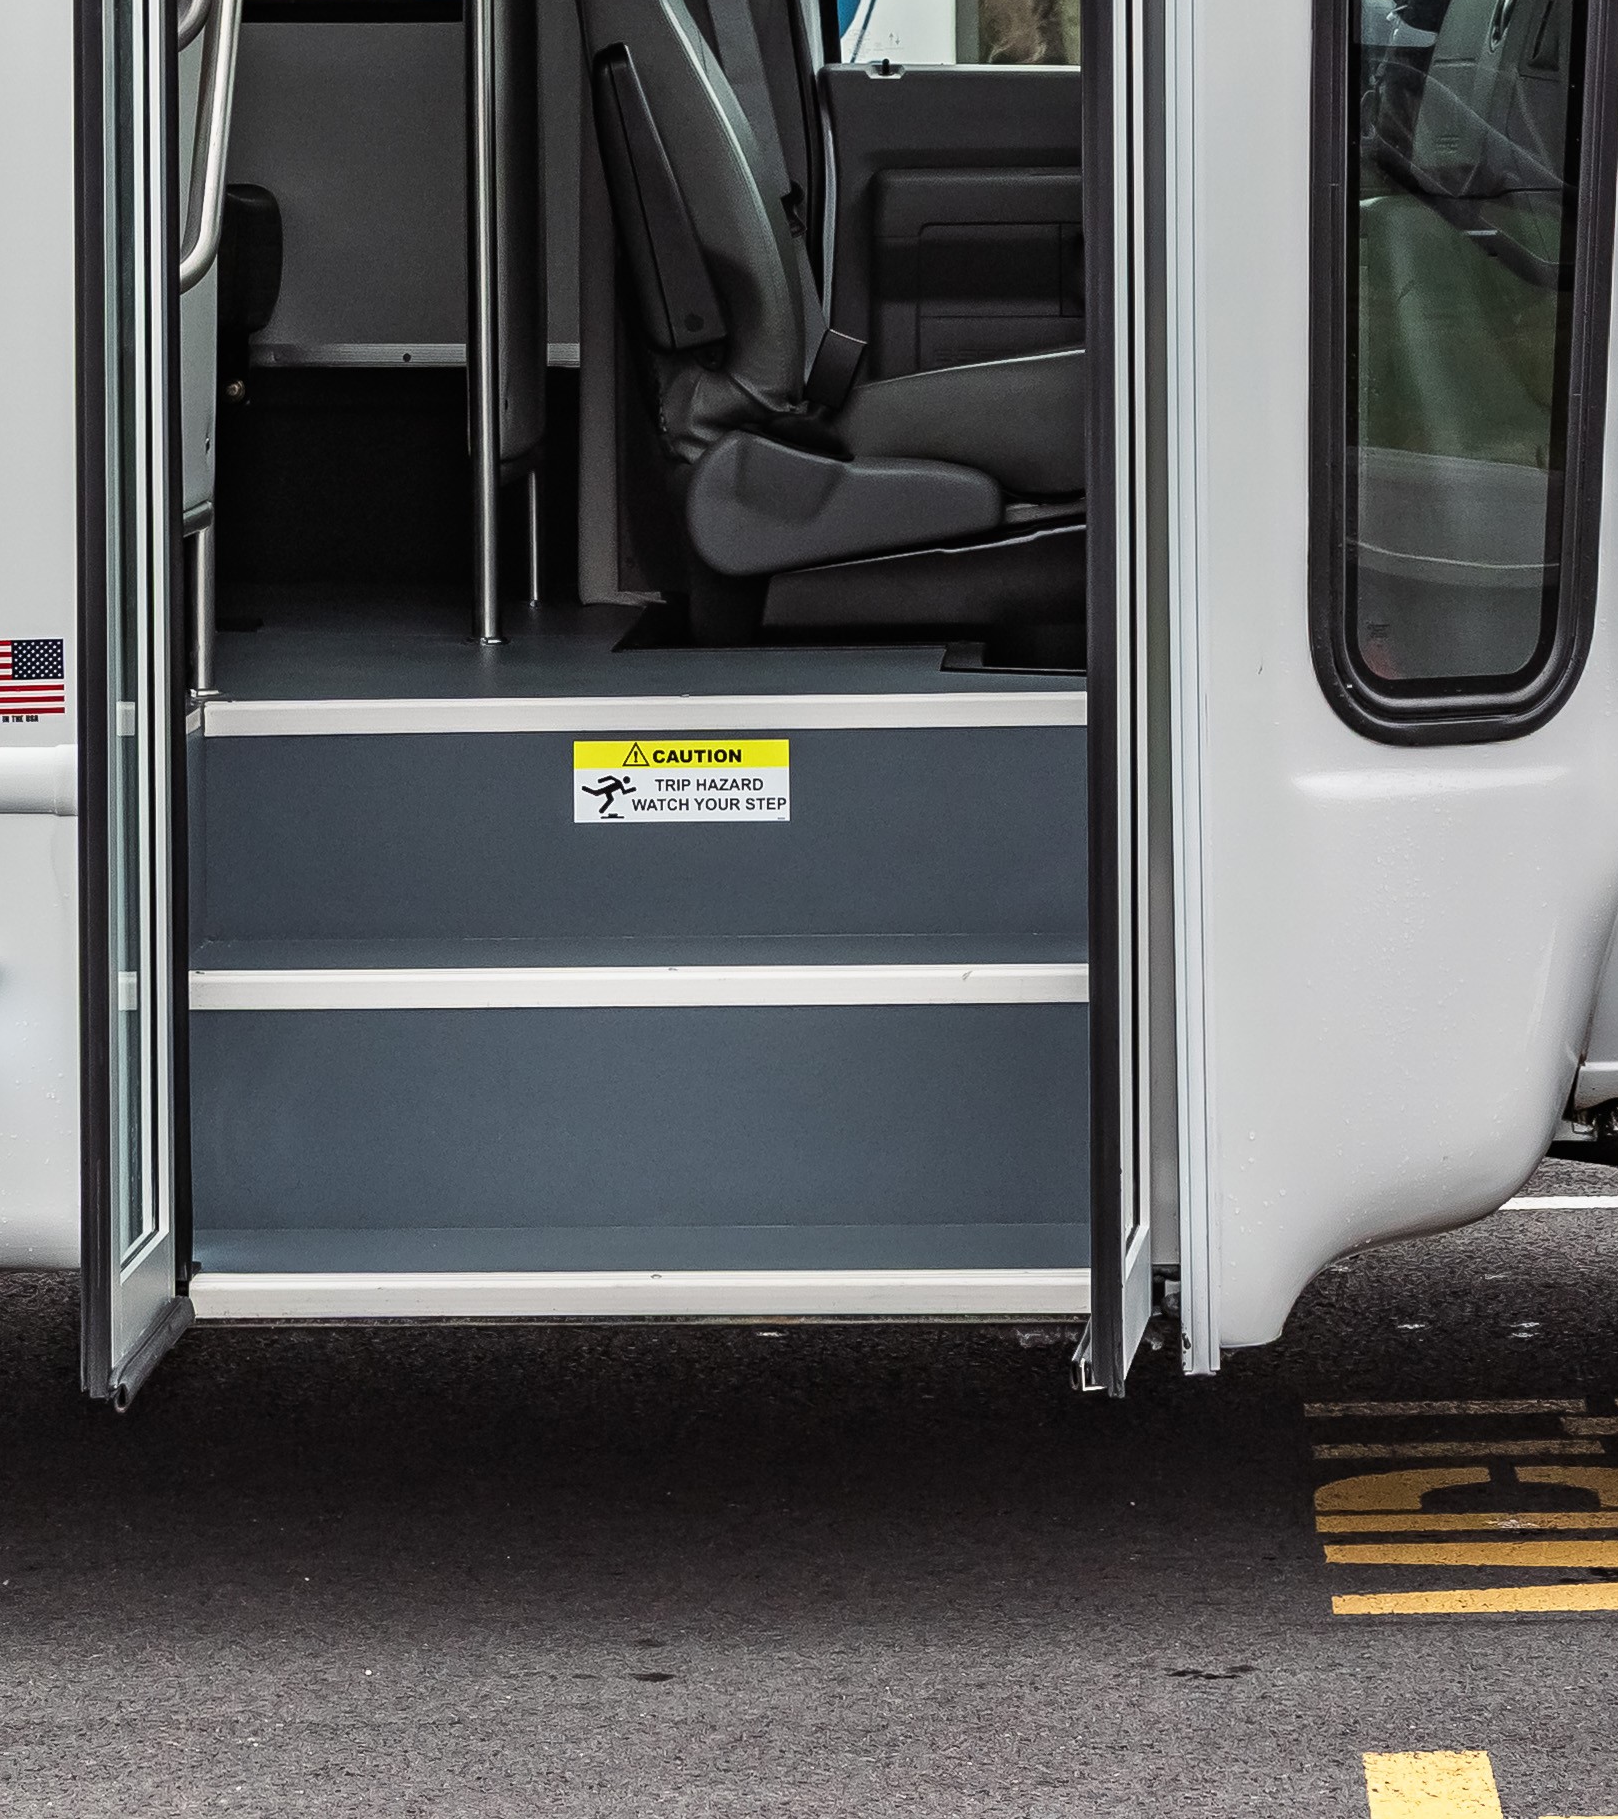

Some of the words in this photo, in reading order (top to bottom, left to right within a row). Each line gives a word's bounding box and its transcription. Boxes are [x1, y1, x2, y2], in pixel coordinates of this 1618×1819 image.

[652, 749, 742, 764] CAUTION
[655, 778, 691, 792] TRIP
[696, 778, 764, 792] HAZARD
[632, 798, 690, 812] WATCH
[694, 797, 741, 811] YOUR
[745, 797, 787, 811] STEP
